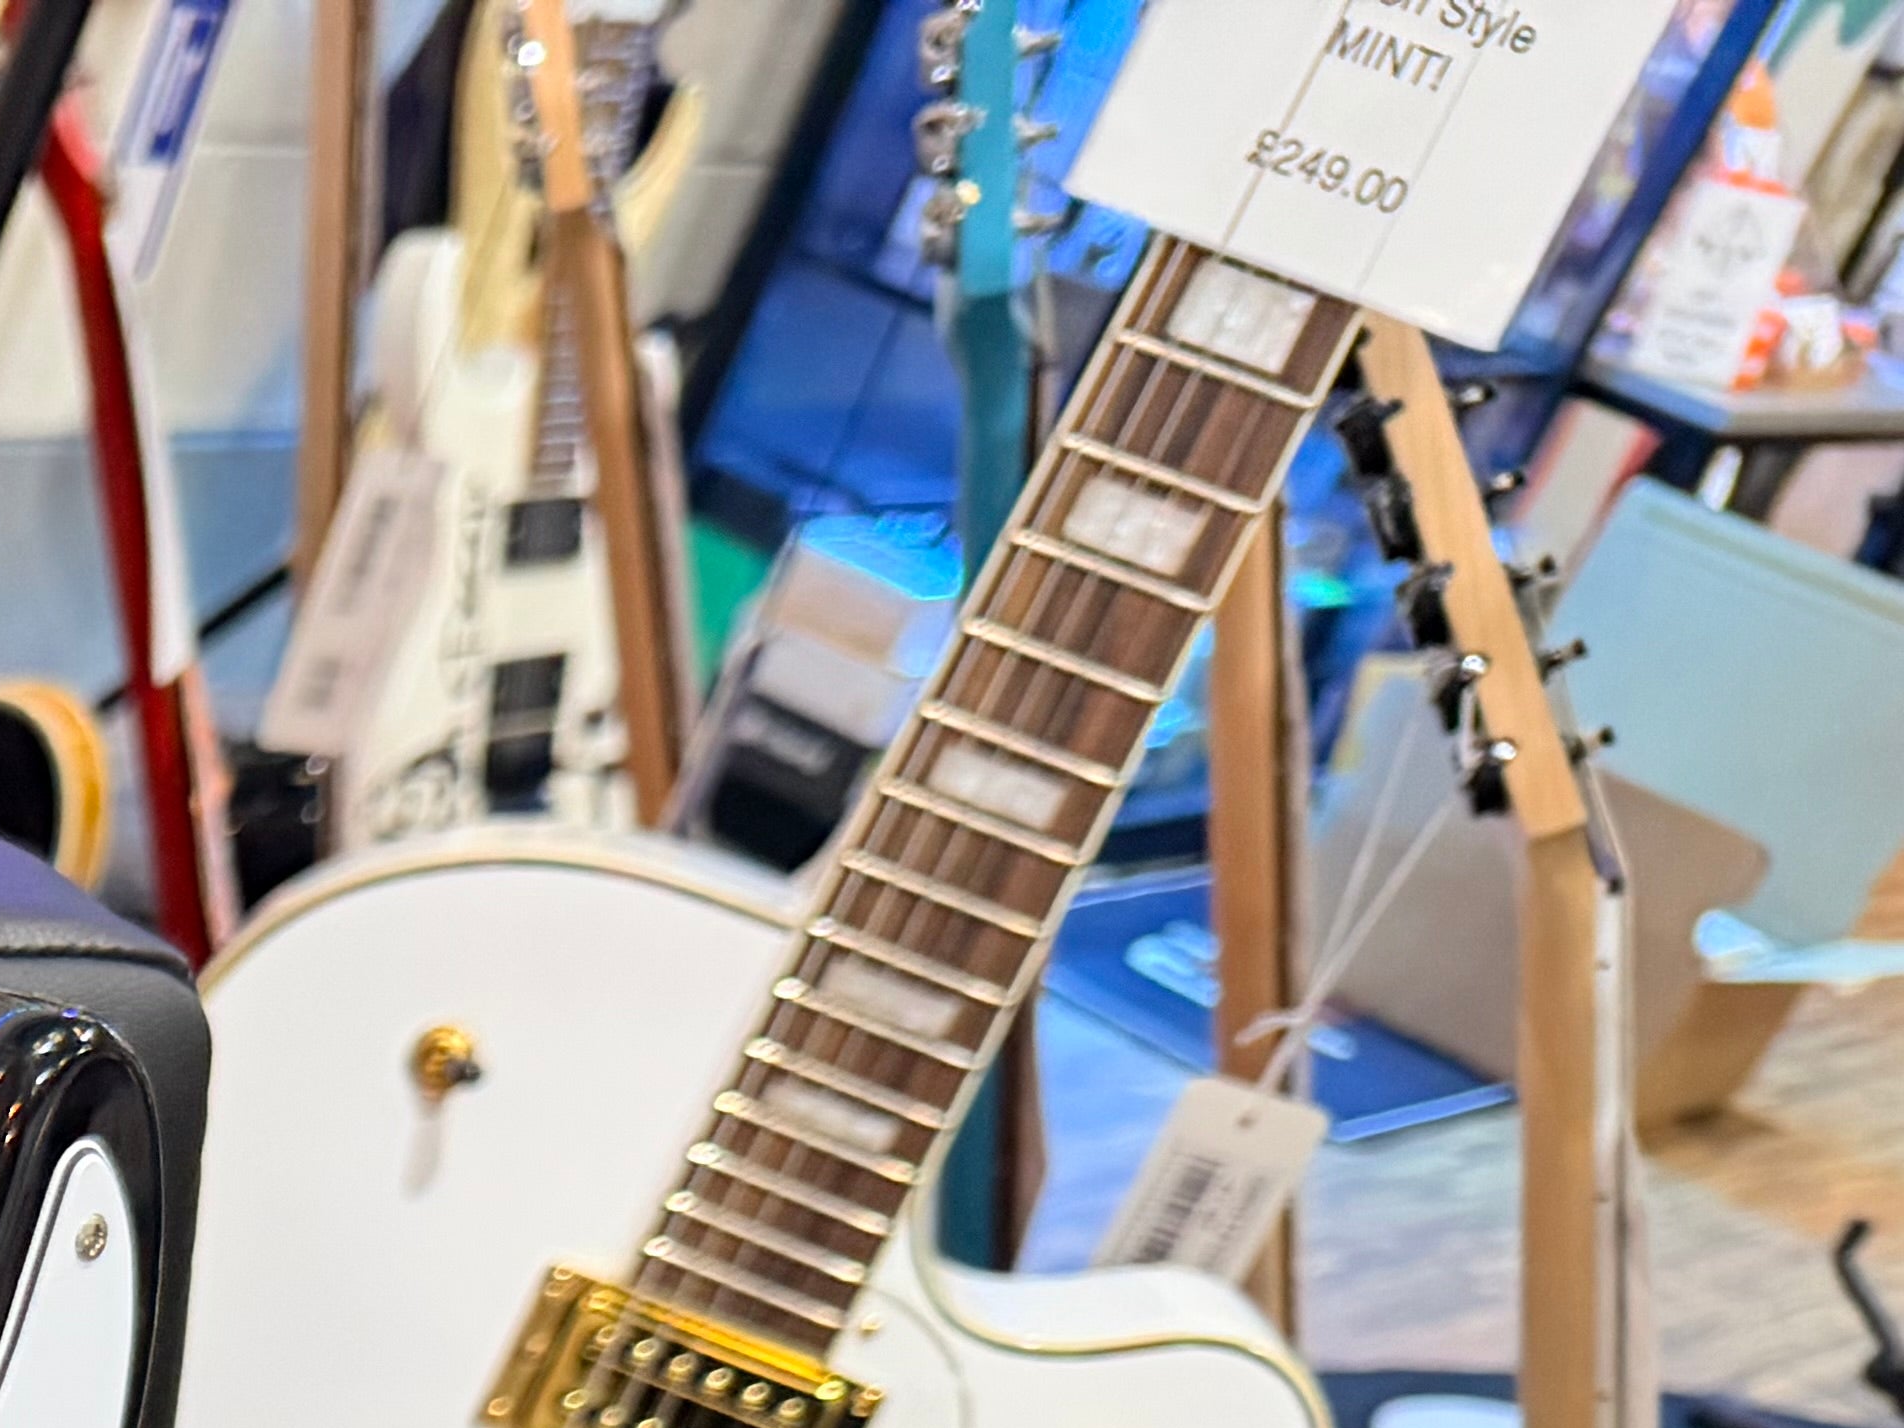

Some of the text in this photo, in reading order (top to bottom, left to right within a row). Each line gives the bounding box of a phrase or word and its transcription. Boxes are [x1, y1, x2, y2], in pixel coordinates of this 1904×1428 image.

[1325, 17, 1453, 92] MINT!
[1439, 0, 1537, 54] Style
[1245, 128, 1409, 214] £249.00
